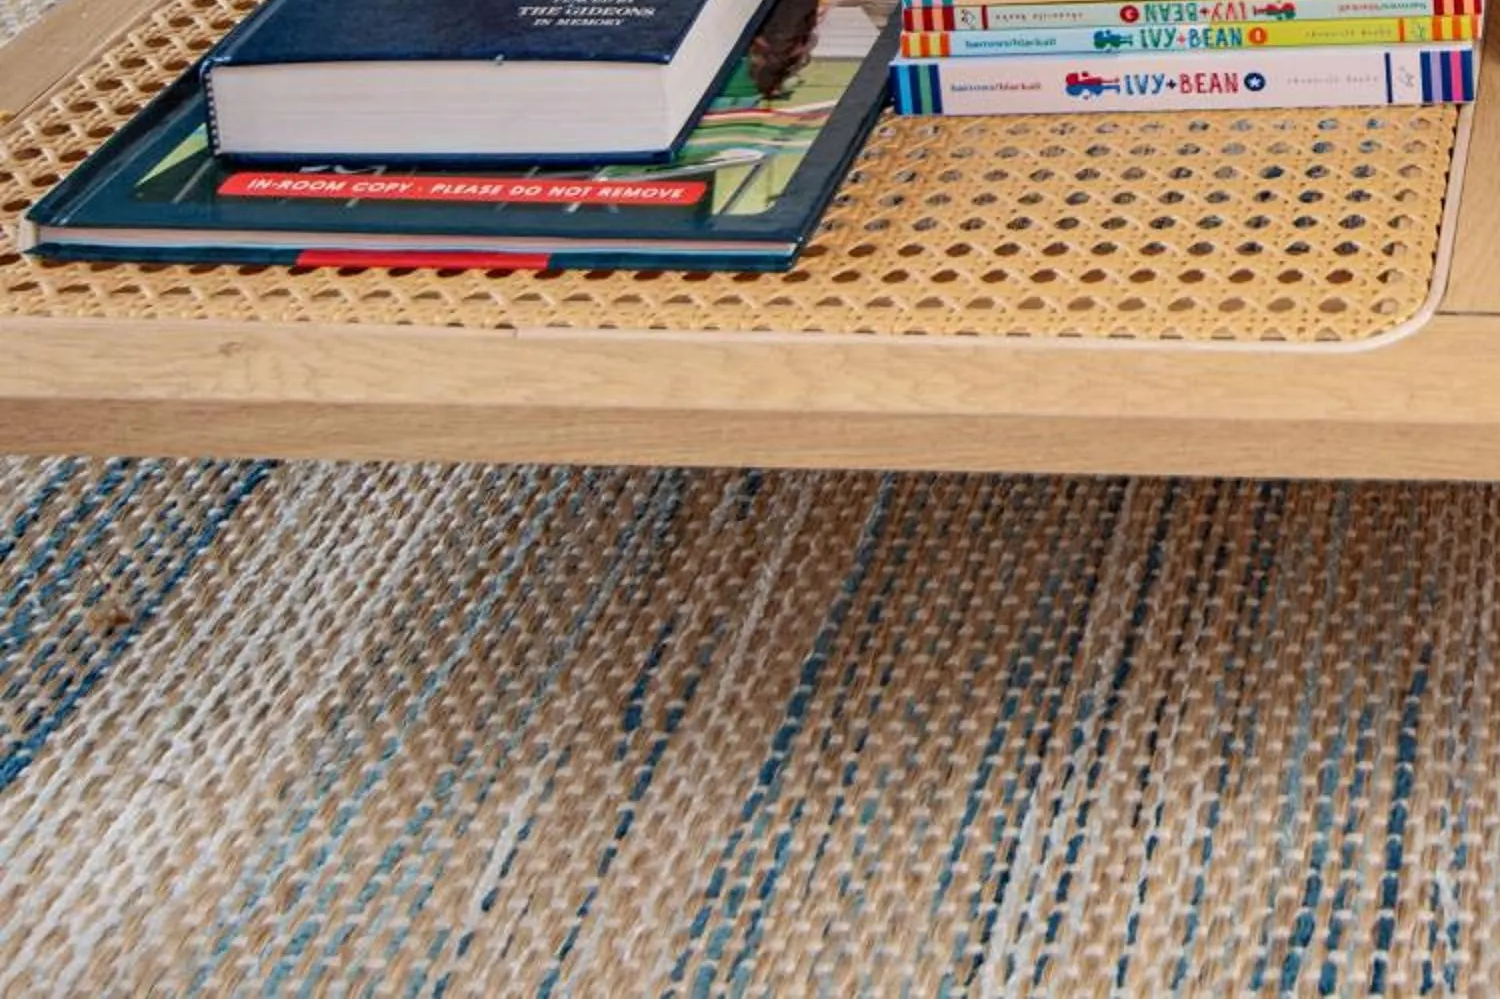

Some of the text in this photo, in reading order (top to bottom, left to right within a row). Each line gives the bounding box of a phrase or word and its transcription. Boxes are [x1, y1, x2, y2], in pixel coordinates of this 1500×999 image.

[518, 5, 656, 17] THE GIDEONS
[533, 17, 625, 27] IN MEMORY
[247, 178, 685, 200] IN-ROOM COPY PLEASE DO NOT REMOVE
